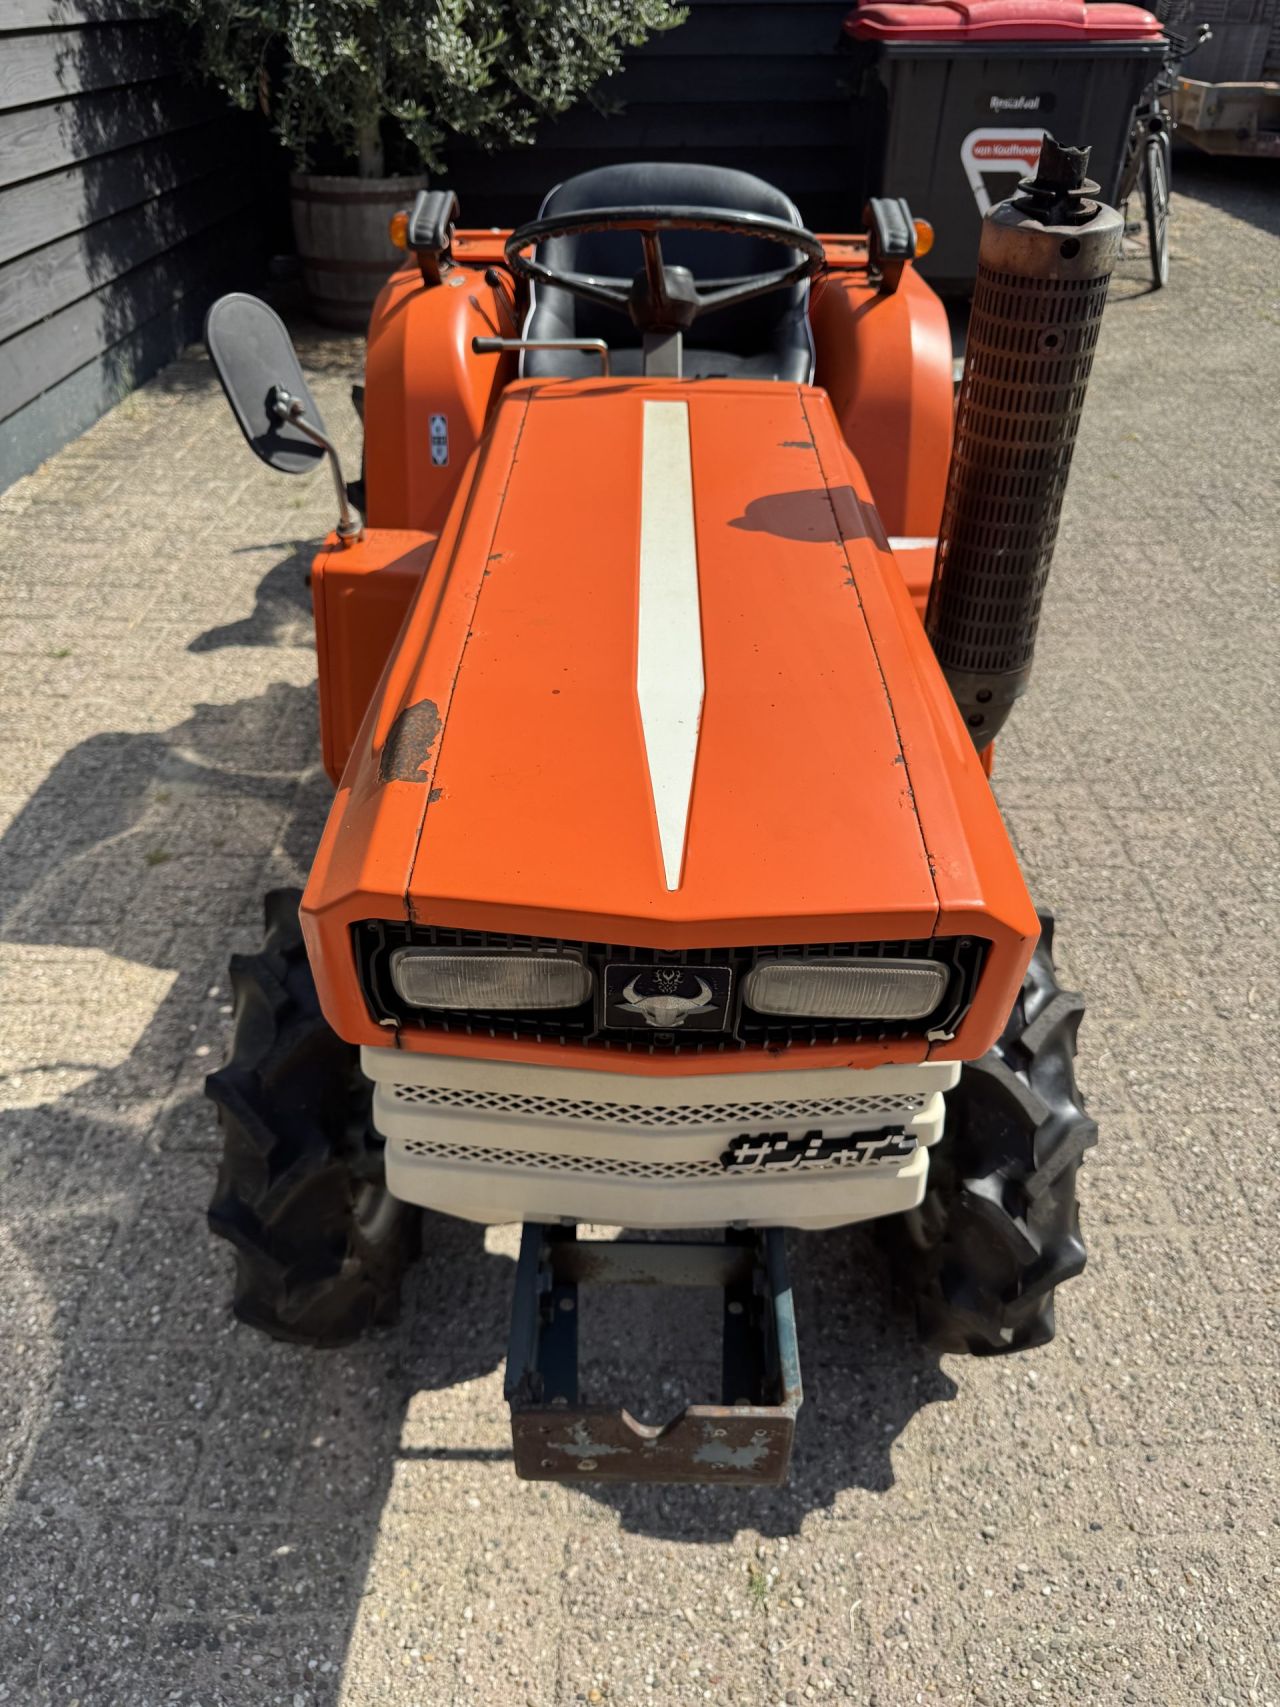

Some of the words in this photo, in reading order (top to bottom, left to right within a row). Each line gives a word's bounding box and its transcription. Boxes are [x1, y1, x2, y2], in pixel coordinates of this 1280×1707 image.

[723, 1130, 918, 1170] サンシャイン
